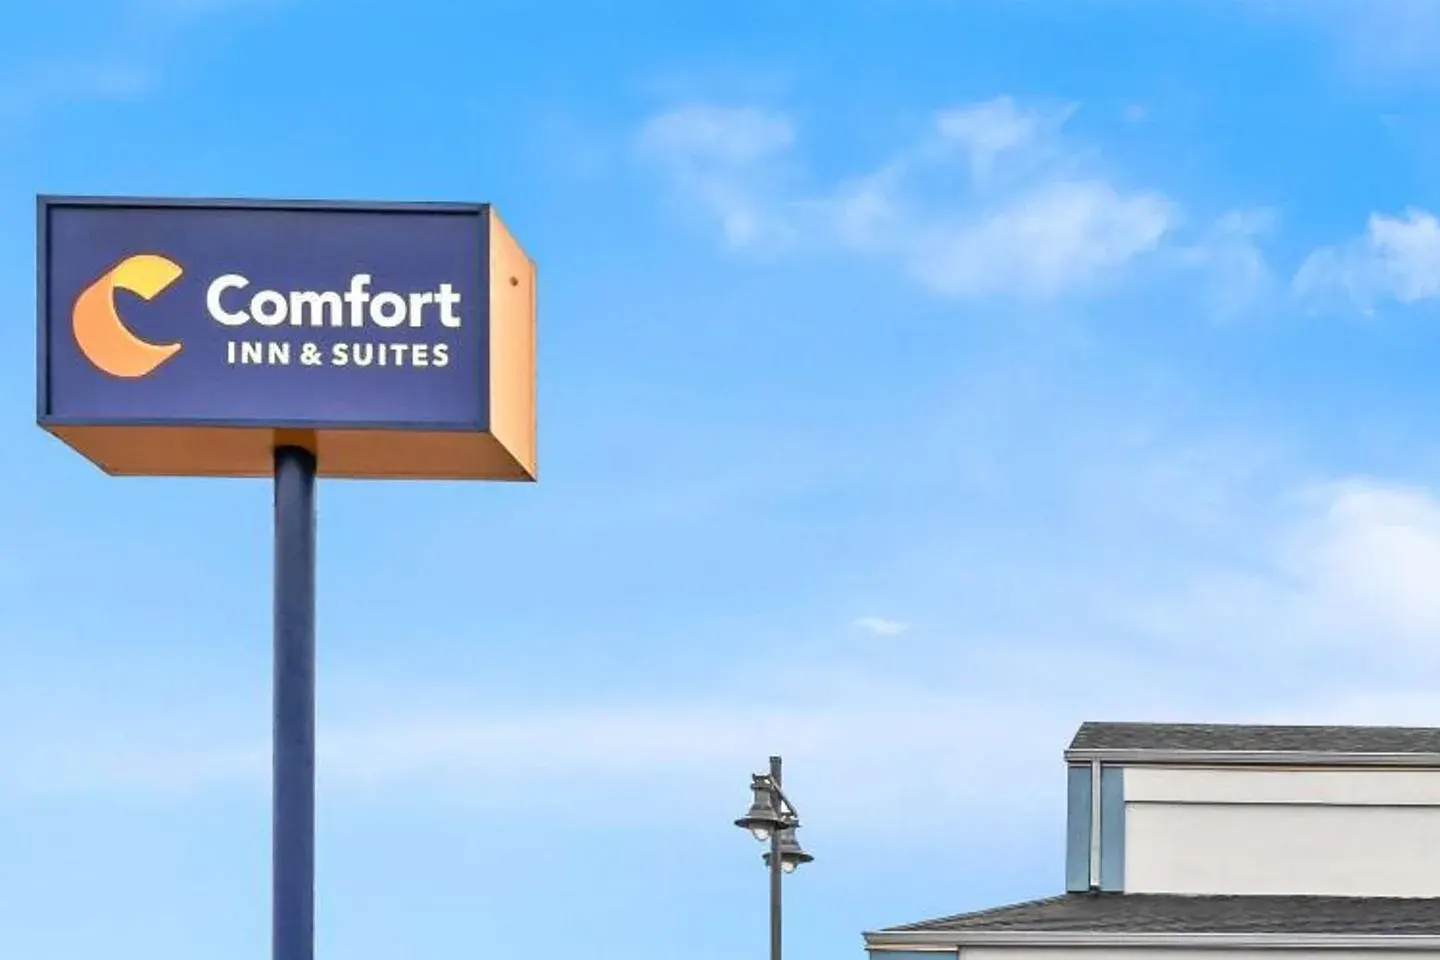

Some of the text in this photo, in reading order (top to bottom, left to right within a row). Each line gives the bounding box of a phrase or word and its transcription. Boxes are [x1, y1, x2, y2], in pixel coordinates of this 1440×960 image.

[206, 273, 461, 328] Comfort
[227, 341, 449, 367] INN & SUITES
